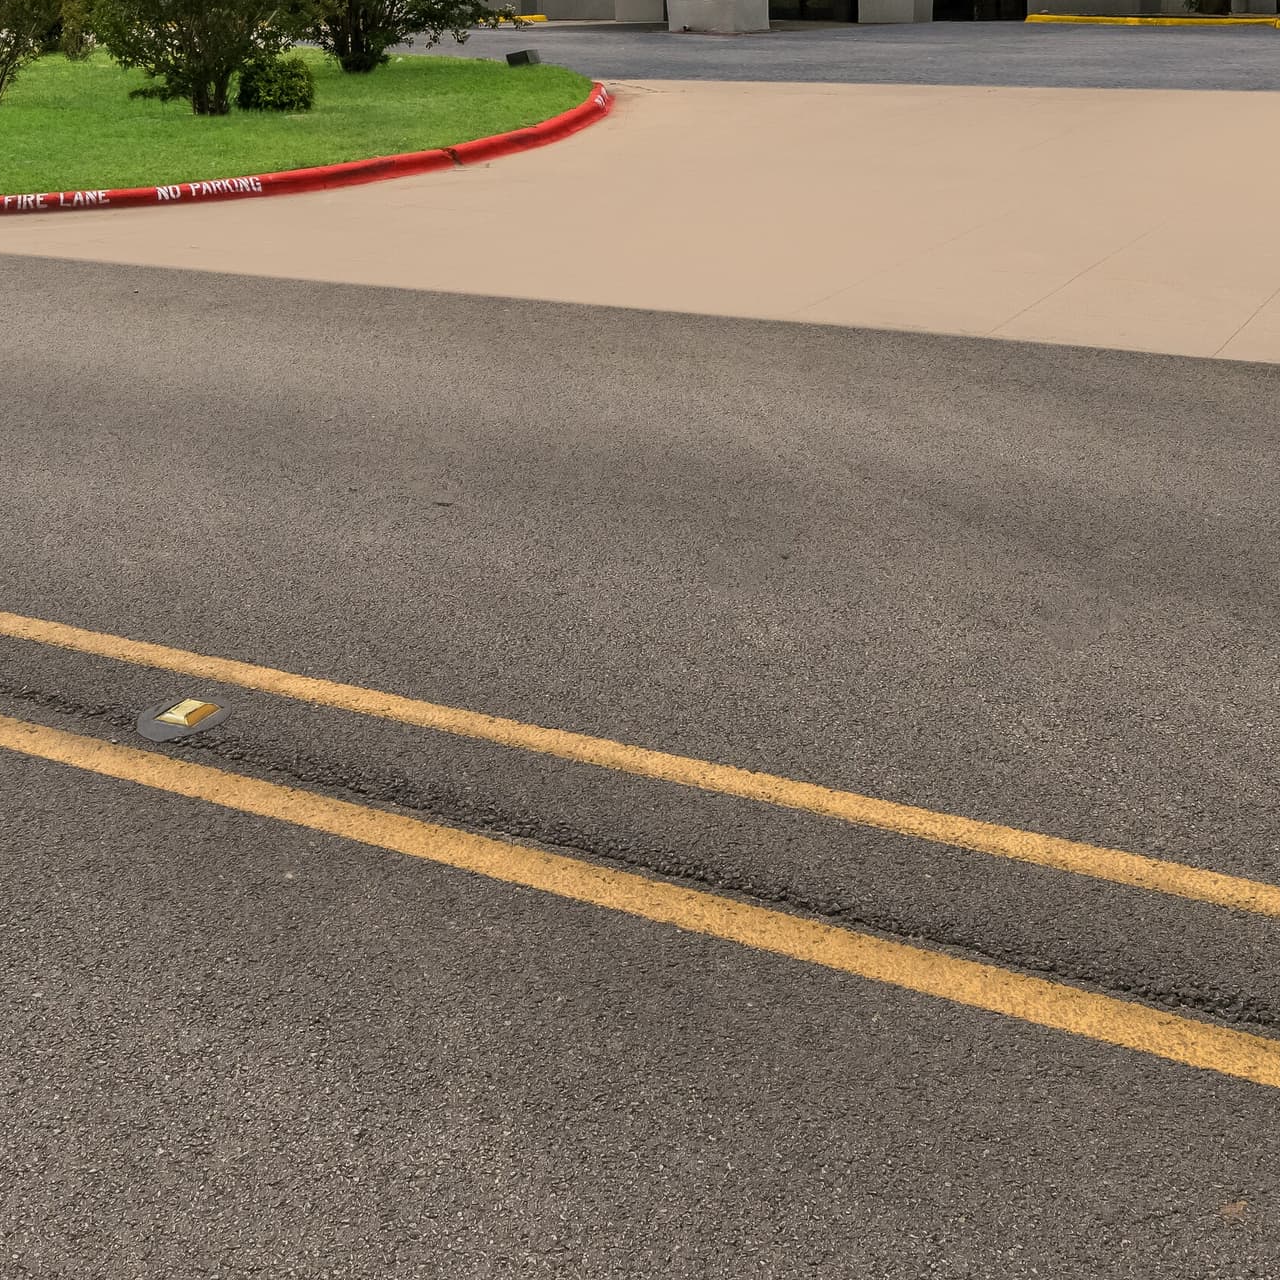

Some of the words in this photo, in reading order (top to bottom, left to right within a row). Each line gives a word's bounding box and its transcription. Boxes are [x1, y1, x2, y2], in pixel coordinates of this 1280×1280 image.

[4, 193, 49, 210] FIRE
[59, 189, 111, 207] LANE
[156, 185, 181, 201] NO
[189, 176, 263, 197] PARKING
